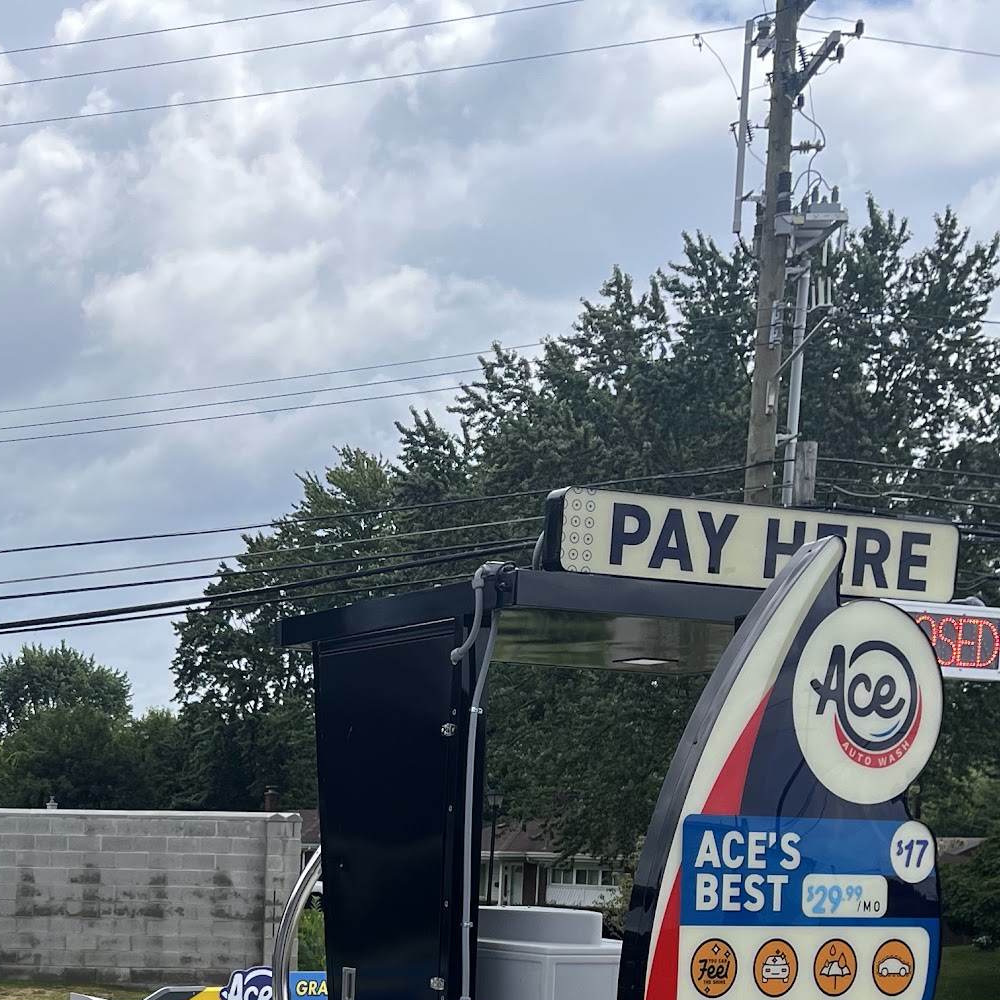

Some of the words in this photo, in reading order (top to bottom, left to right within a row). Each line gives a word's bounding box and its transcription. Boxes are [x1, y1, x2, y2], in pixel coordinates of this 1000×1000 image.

[609, 502, 740, 575] PAY
[762, 518, 932, 593] HRE
[810, 644, 906, 719] Ace
[841, 740, 872, 766] AUTO
[877, 740, 910, 767] WASH
[694, 829, 801, 871] ACE'S
[896, 839, 929, 868] $17
[695, 873, 789, 912] BEST
[807, 884, 863, 914] $29.99
[697, 958, 730, 981] Feel
[296, 980, 328, 996] GRA
